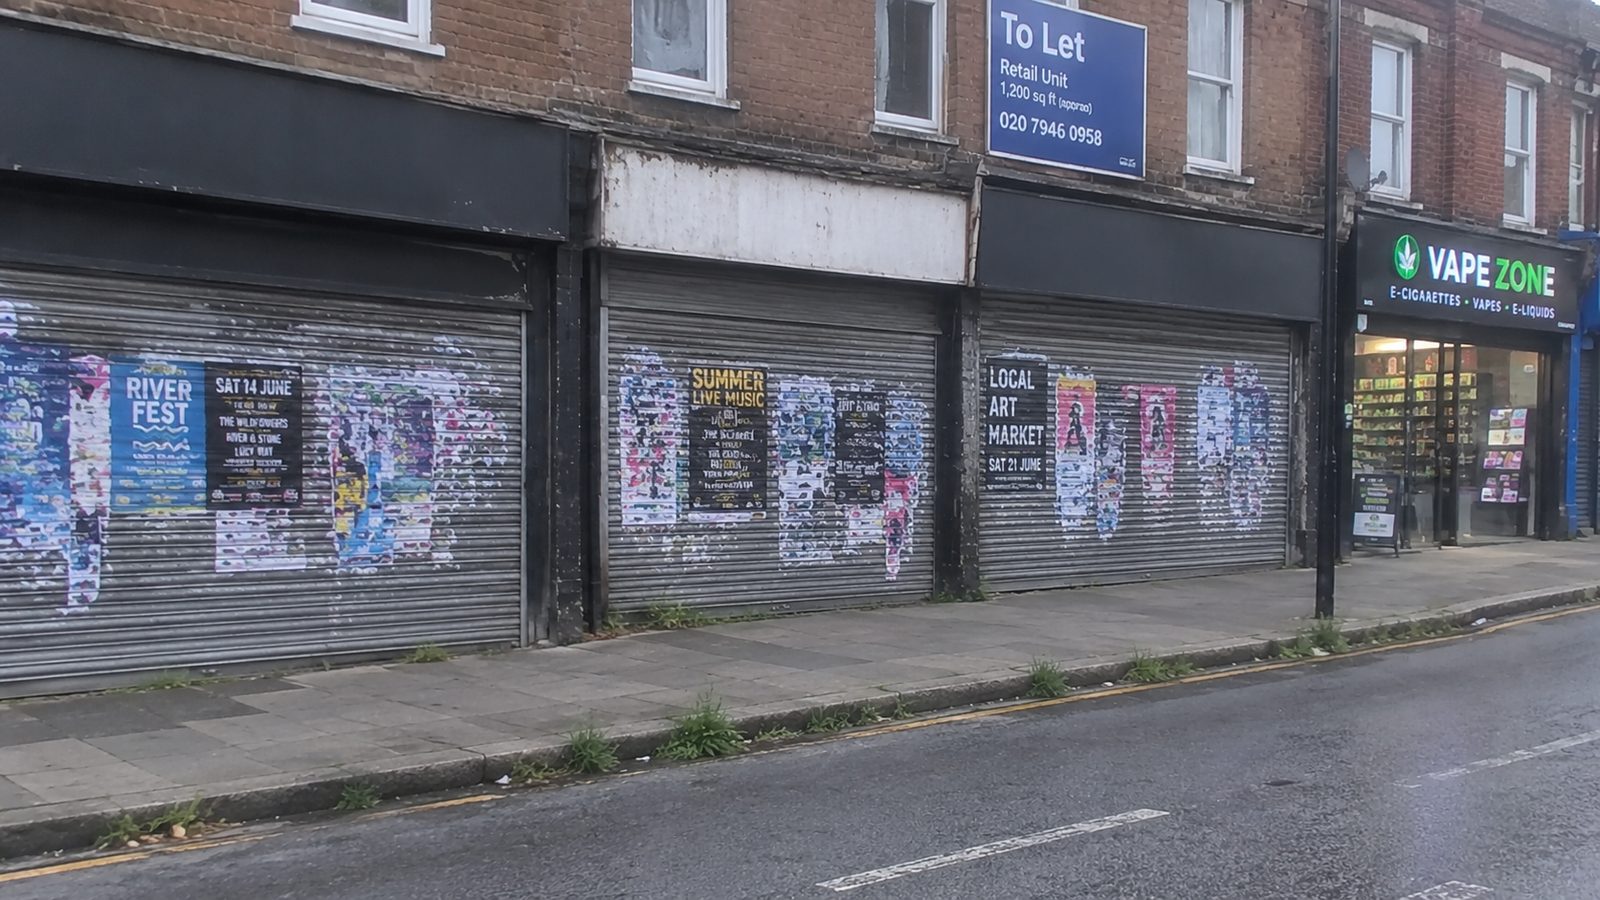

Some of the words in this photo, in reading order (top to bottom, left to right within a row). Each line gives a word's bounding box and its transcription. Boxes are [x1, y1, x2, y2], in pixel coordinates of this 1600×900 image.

[1000, 11, 1034, 50] To
[1042, 21, 1086, 63] Let
[1000, 58, 1038, 83] Retail
[1041, 67, 1069, 89] Unit
[1000, 81, 1030, 101] 1,200
[1032, 90, 1046, 107] sq
[1048, 91, 1057, 106] ft
[999, 111, 1028, 133] 020
[1031, 117, 1066, 140] 7946
[1069, 125, 1103, 147] 0958
[1428, 245, 1491, 288] VAPE
[1495, 258, 1556, 297] ZONE
[1472, 296, 1502, 313] VAPES
[1512, 302, 1555, 319] E-LIQUIDS
[126, 376, 193, 401] RIVER
[215, 377, 241, 394] SAT
[243, 378, 258, 395] 14
[260, 379, 292, 396] JUNE
[692, 367, 765, 391] SUMMER
[989, 365, 1036, 390] LOCAL
[692, 390, 721, 406] LIVE
[725, 391, 765, 408] MUSIC
[988, 395, 1019, 417] ART
[132, 400, 189, 425] FEST
[988, 424, 1045, 446] MARKET
[988, 457, 1007, 472] SAT
[1007, 457, 1018, 472] 21
